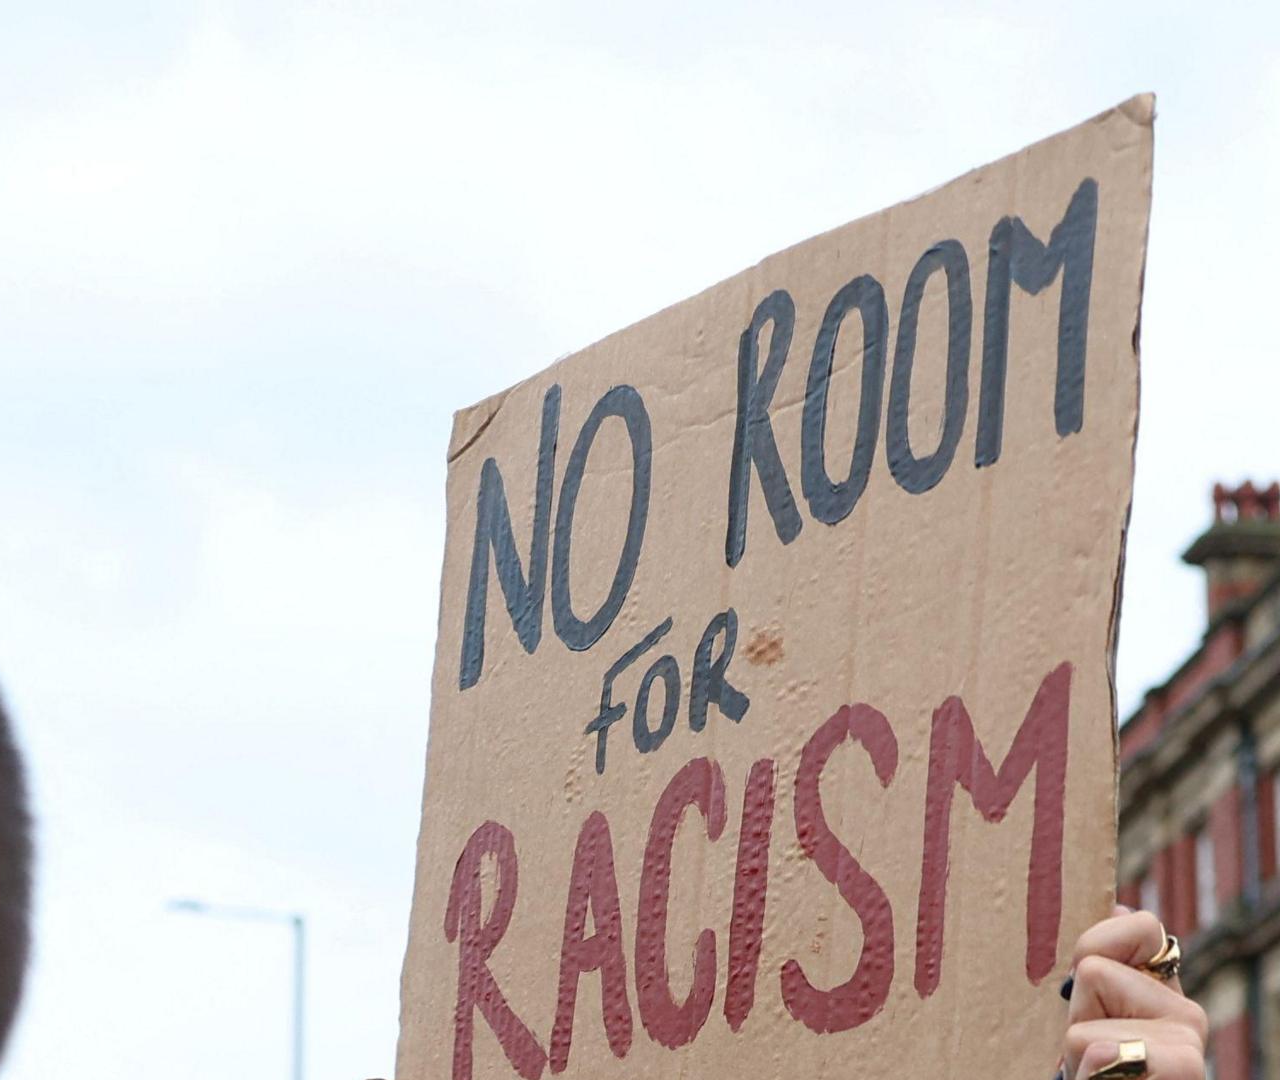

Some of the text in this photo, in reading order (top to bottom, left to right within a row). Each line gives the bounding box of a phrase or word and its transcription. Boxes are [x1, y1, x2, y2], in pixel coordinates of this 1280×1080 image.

[459, 177, 1098, 691] NO ROOM
[585, 608, 750, 774] FOR
